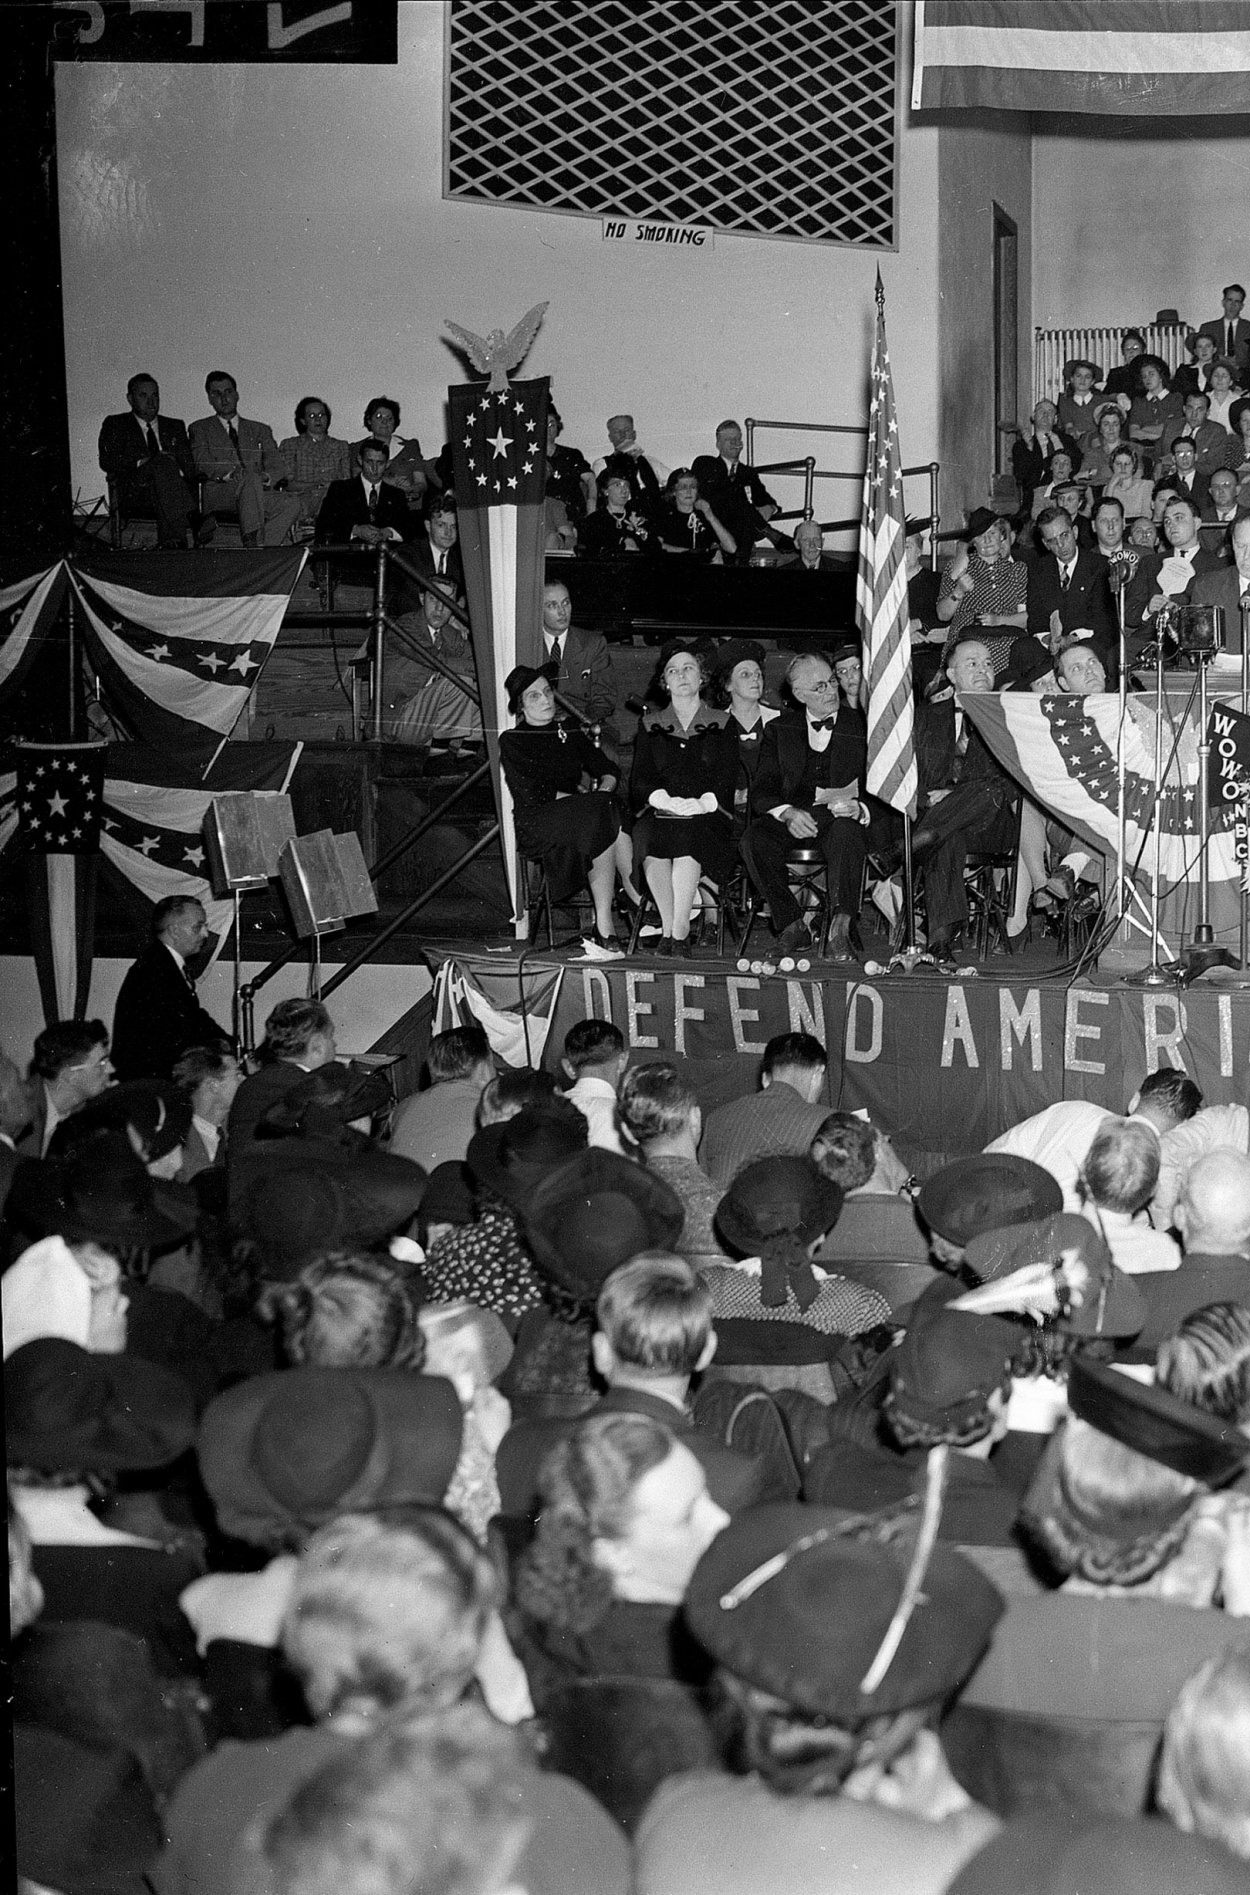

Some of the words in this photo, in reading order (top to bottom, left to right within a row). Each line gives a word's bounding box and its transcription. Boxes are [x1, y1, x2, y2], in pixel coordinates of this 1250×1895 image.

[605, 222, 626, 238] NO
[635, 224, 706, 246] SMOKING
[1235, 803, 1248, 859] NBC
[582, 968, 884, 1063] DEFEND
